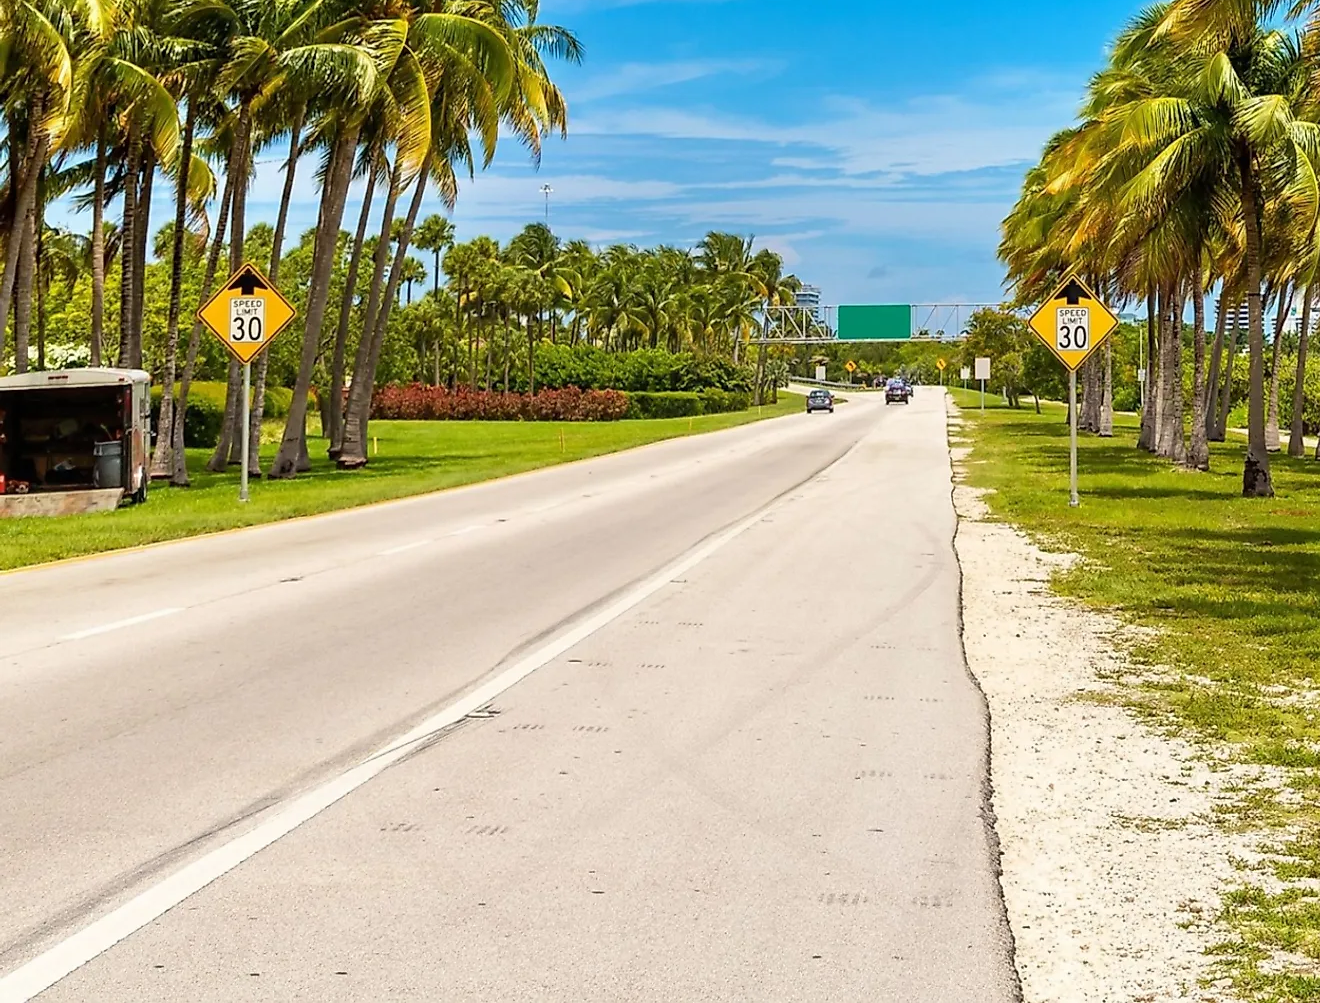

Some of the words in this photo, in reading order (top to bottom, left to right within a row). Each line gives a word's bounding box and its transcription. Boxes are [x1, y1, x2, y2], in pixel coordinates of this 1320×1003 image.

[233, 300, 262, 308] SPEED
[236, 308, 258, 316] LIMIT
[1059, 309, 1087, 317] SPEED
[1062, 317, 1083, 325] LIMIT
[232, 316, 262, 341] 30
[1059, 325, 1087, 349] 30
